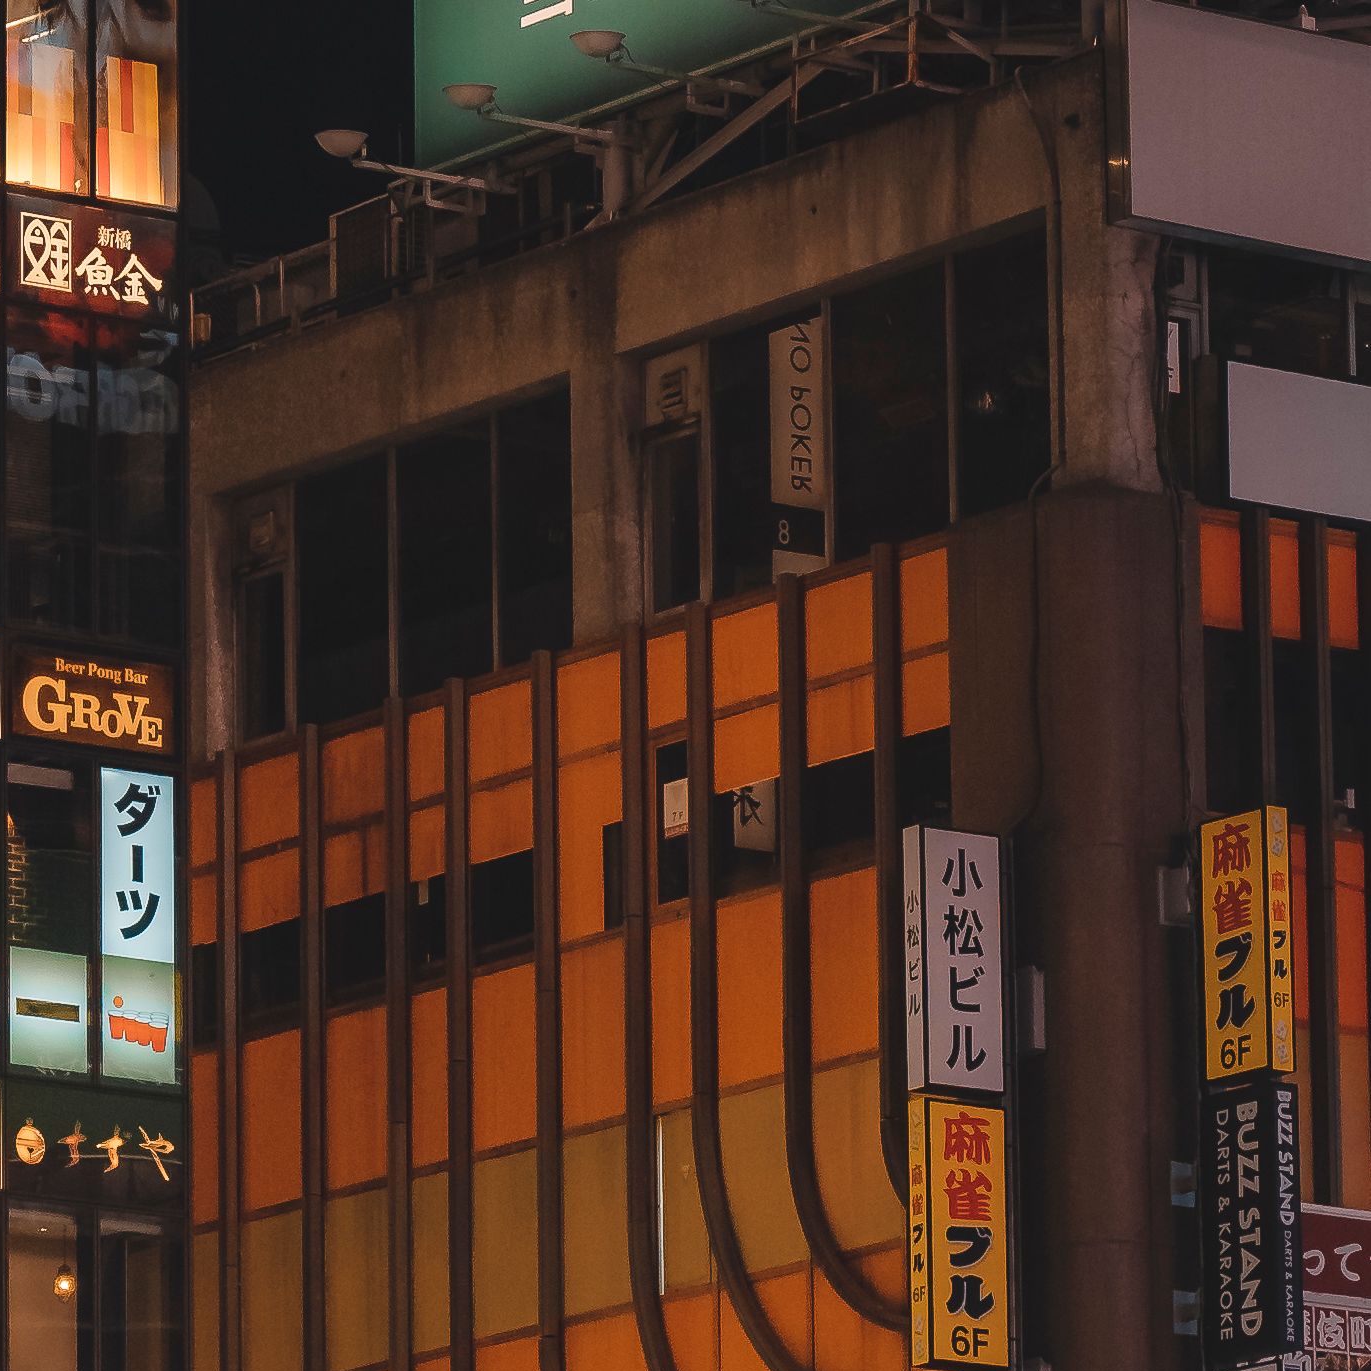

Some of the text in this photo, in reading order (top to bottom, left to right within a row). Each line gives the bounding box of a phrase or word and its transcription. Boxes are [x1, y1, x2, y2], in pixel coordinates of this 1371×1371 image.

[98, 225, 131, 251] 新橋
[75, 246, 163, 305] 魚金
[55, 657, 149, 685] Beer Pong Bar
[22, 676, 163, 748] GROVE
[114, 782, 161, 940] ダーツ
[906, 889, 921, 1018] 小松ビル
[942, 848, 987, 1073] 小松ビル
[1212, 822, 1256, 1031] 麻雀ブル
[1271, 868, 1288, 981] 麻雀ブル
[1273, 990, 1290, 1008] 6F
[1220, 1033, 1252, 1070] 6F
[1274, 1090, 1296, 1227] BUZZ STAND
[943, 1110, 996, 1321] 麻雀ブル
[1215, 1108, 1234, 1341] DARTS & KARAOKE
[1236, 1100, 1264, 1337] BUZZ STAND
[1284, 1230, 1293, 1267] DARTS
[913, 1284, 926, 1304] 6F
[1285, 1284, 1296, 1344] KARAOKE
[951, 1324, 990, 1358] 6F
